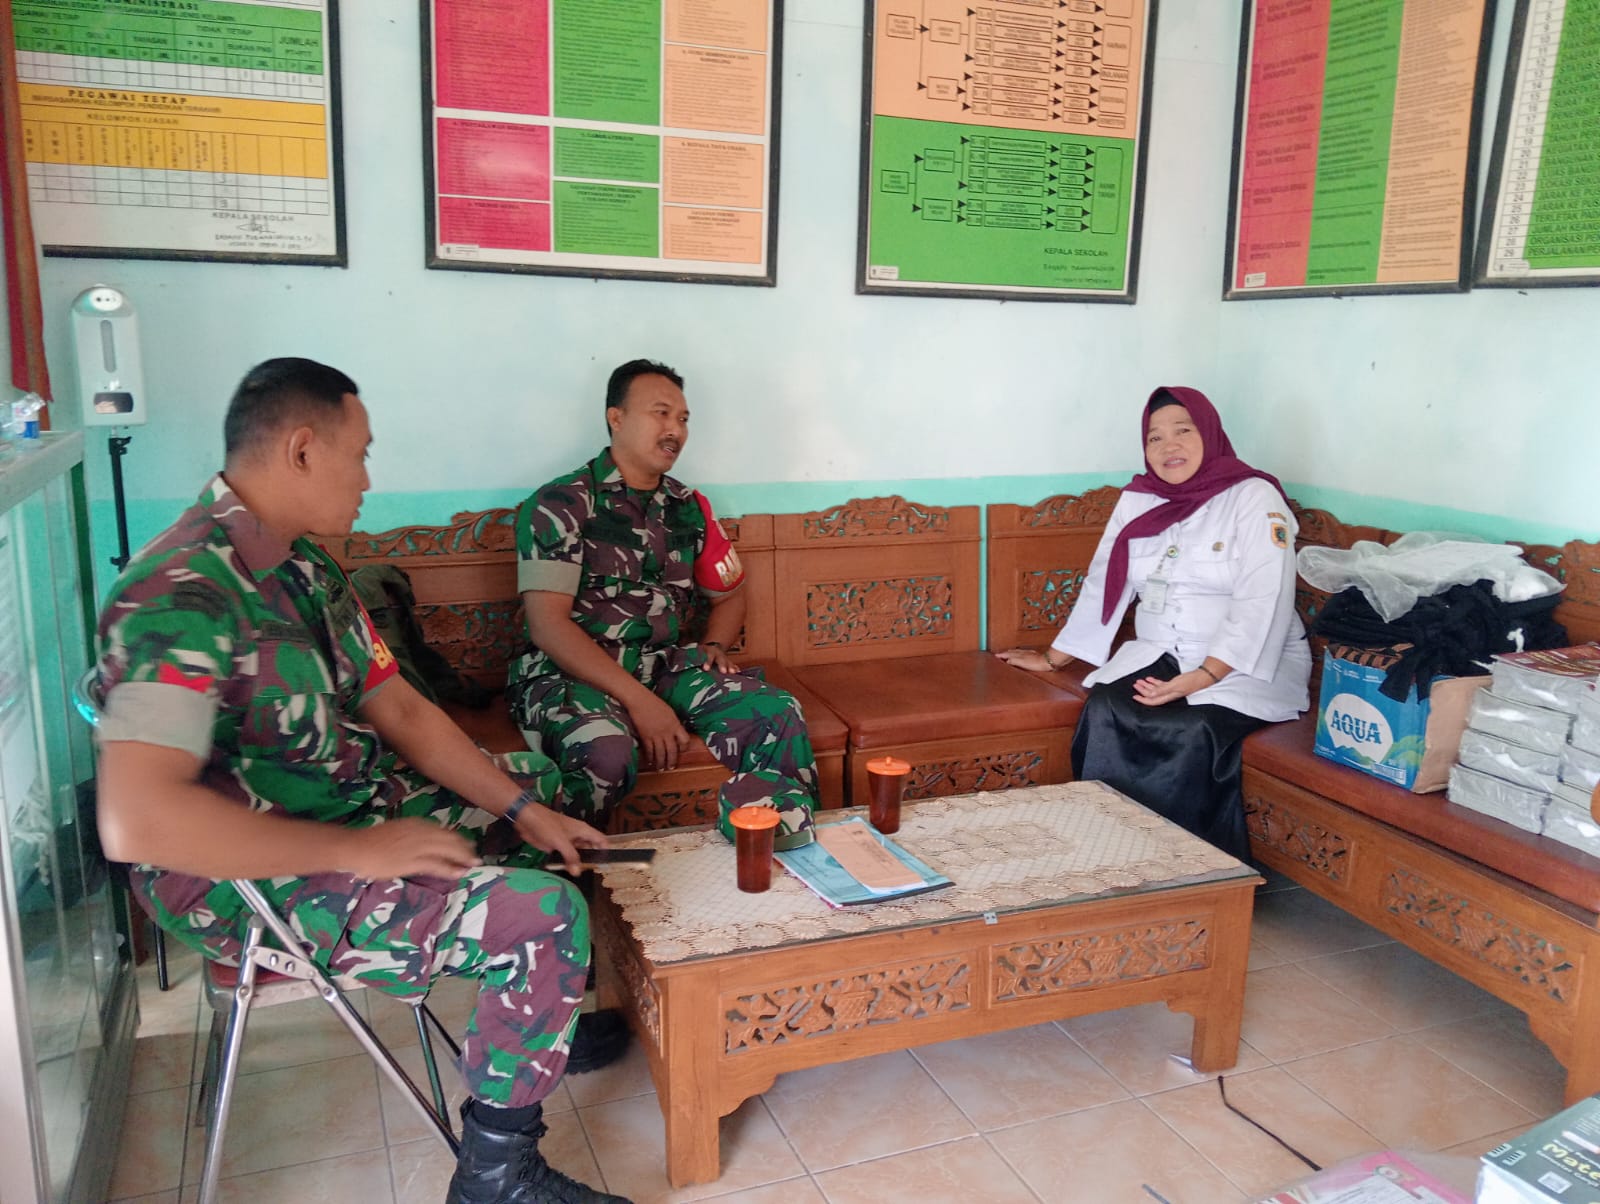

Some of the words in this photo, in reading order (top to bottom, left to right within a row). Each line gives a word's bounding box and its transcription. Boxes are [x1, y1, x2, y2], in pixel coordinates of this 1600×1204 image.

[68, 89, 136, 101] PEGAWAI
[142, 95, 187, 104] TETAP
[87, 113, 140, 122] KELOMPOK
[212, 212, 249, 220] KEPALA
[1044, 247, 1073, 256] KEPALA
[1074, 249, 1109, 257] SEKOLAH
[1330, 710, 1382, 745] AQUA
[1542, 1143, 1600, 1181] Mate
